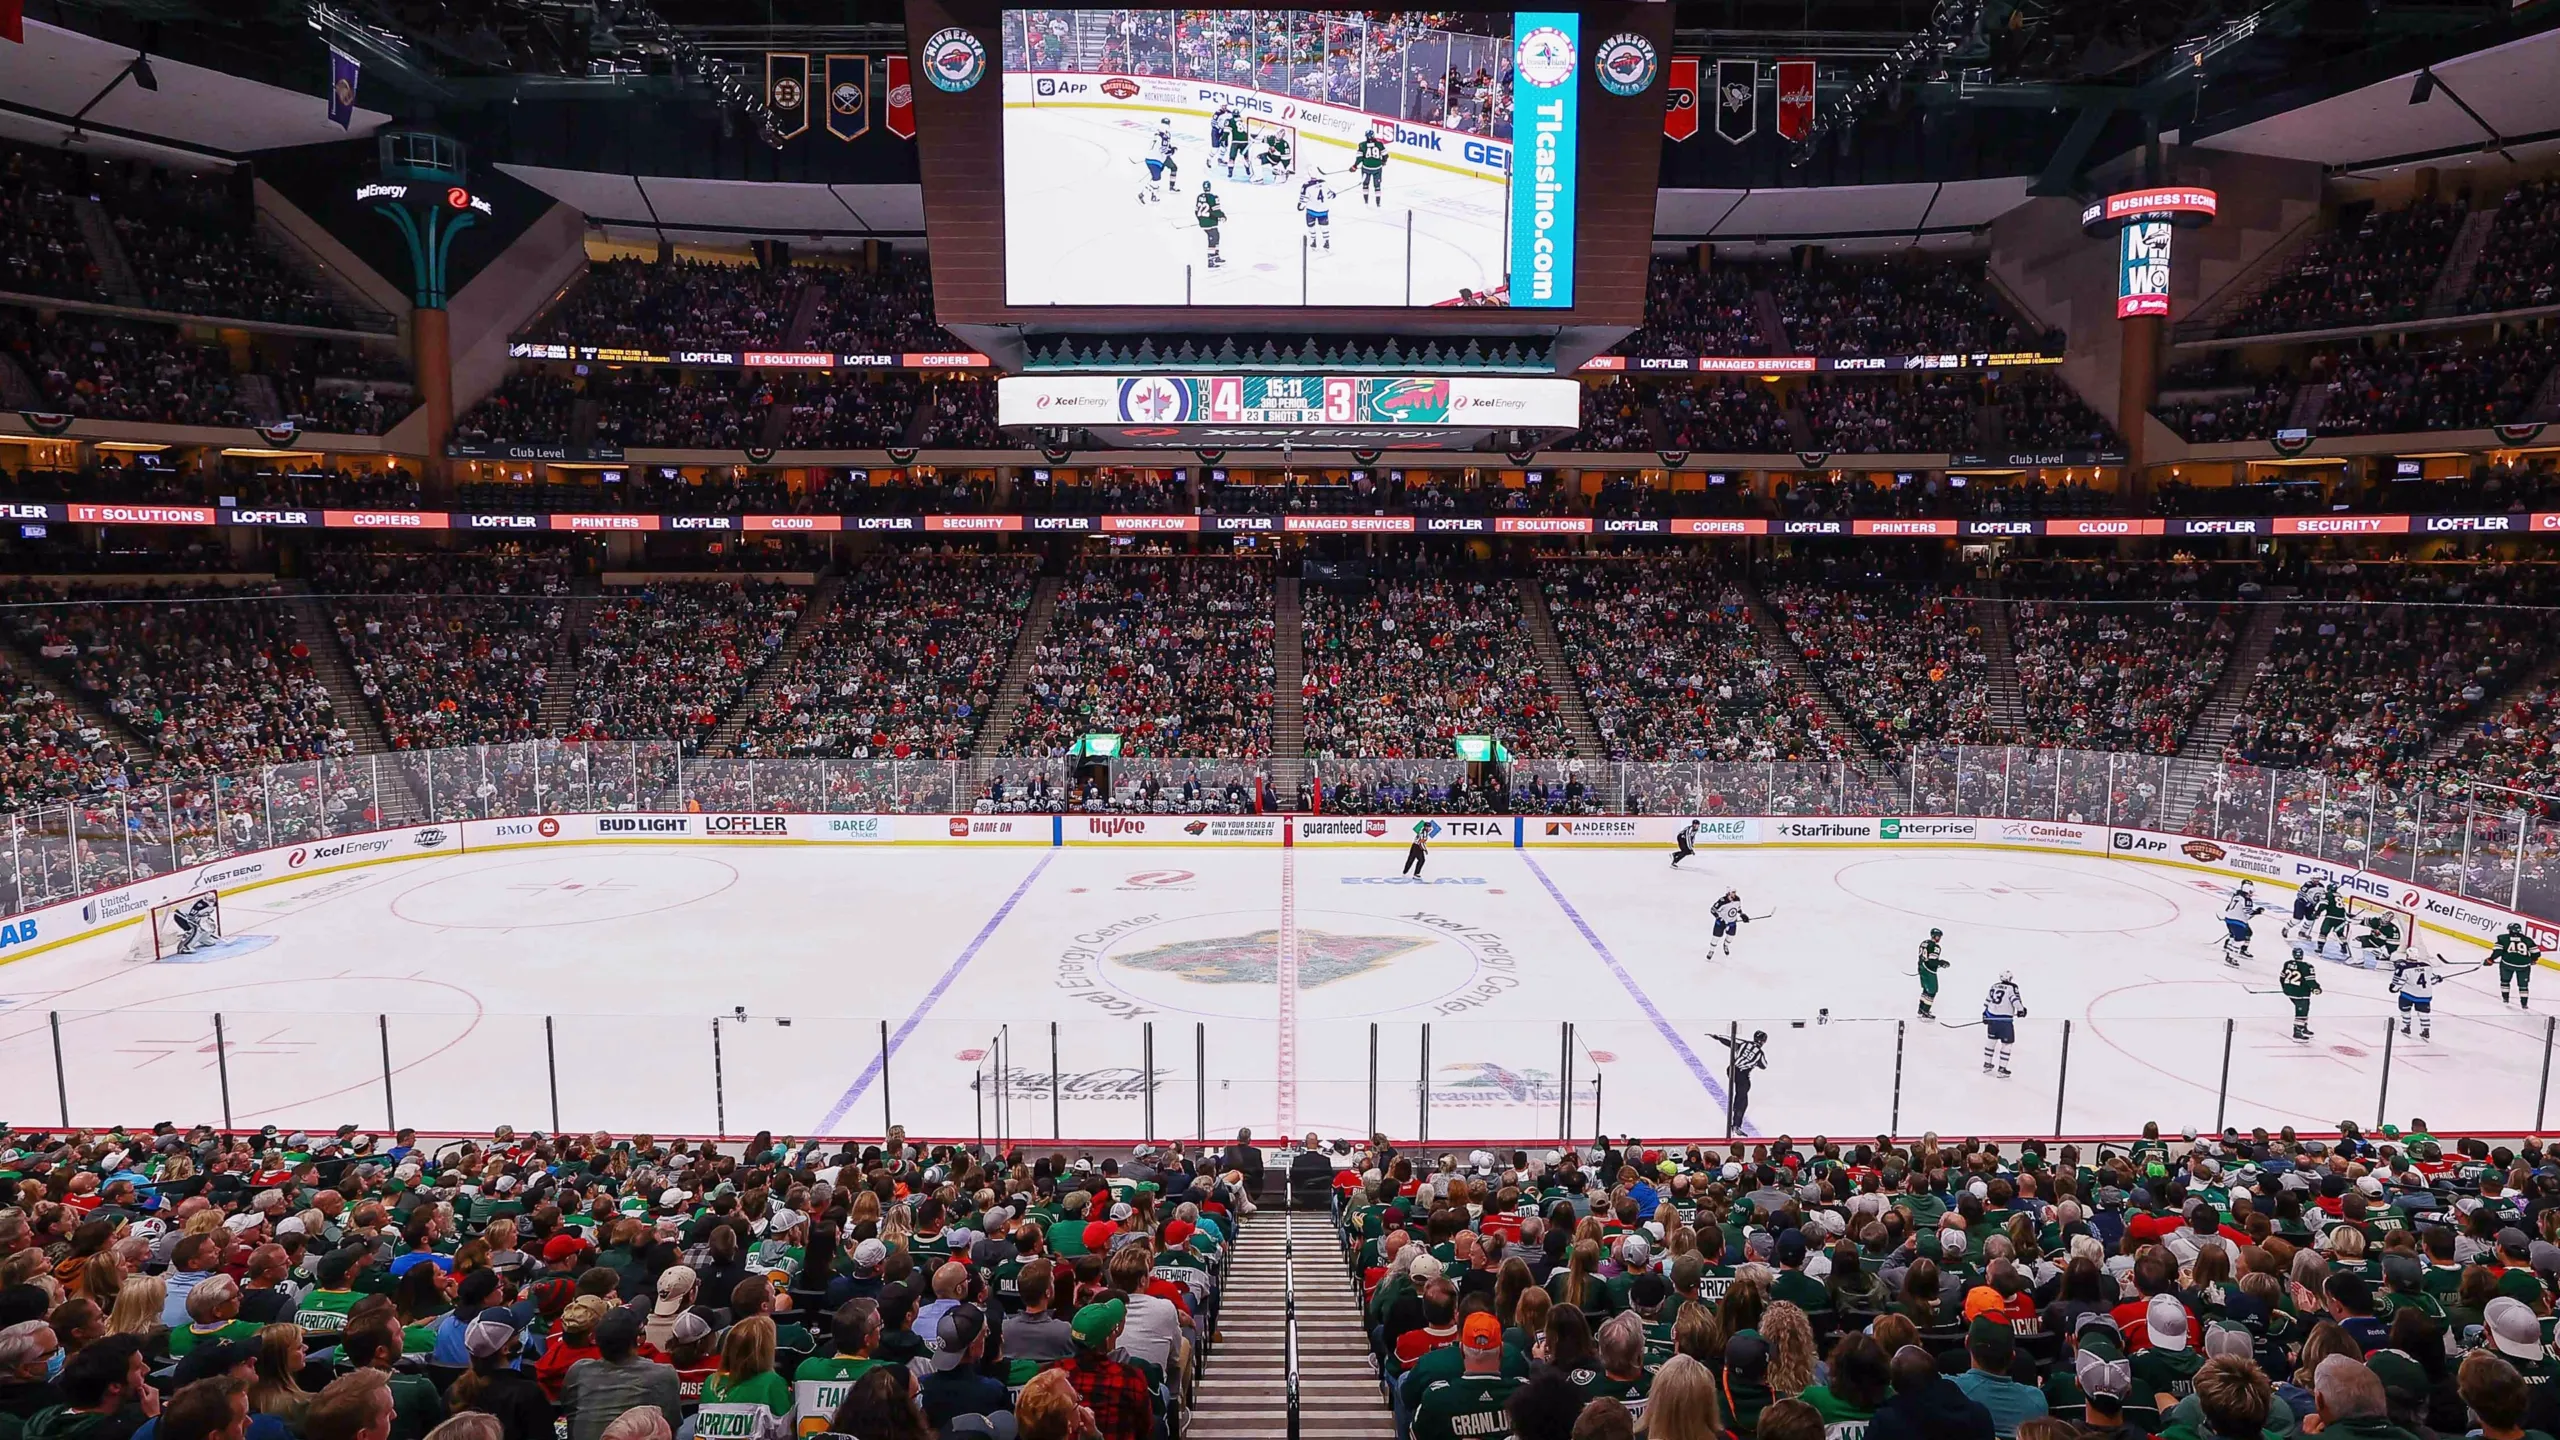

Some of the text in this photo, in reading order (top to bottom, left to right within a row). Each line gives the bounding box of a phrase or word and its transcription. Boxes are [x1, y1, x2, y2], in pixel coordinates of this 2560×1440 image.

[926, 30, 984, 56] MINNESOTA
[1597, 33, 1655, 61] MINNESOTA
[941, 78, 971, 90] WILD
[1611, 81, 1649, 92] WILD
[1300, 109, 1352, 132] Xcel Energy
[1396, 127, 1442, 152] bank
[369, 184, 407, 198] Energy
[1317, 189, 1324, 203] 4
[2111, 194, 2180, 212] BUSINESS
[681, 352, 733, 364] LOFFLER
[750, 355, 827, 365] IT SOLUTIONS
[844, 355, 892, 366] LOFFLER
[922, 355, 969, 365] COPIERS
[1640, 358, 1688, 369] LOFFLER
[1703, 359, 1811, 369] MANAGED SERVICES
[1834, 358, 1885, 370] LOFFLER
[1265, 380, 1302, 397] 15:11
[1055, 397, 1109, 407] Xcel Energy
[1214, 381, 1239, 420] 4
[1260, 398, 1308, 409] 3RD PERIOD
[1328, 382, 1352, 421] 3
[1472, 398, 1527, 409] Xcel Energy
[1247, 411, 1320, 421] 23 SHOTS 25
[510, 448, 565, 459] Club Level
[2009, 454, 2063, 465] Club Level
[79, 507, 205, 522] IT SOLUTIONS
[232, 511, 308, 524] LOFFLER
[353, 514, 421, 526] COPIERS
[471, 515, 536, 527] LOFFLER
[571, 517, 639, 528] PRINTERS
[672, 517, 730, 529] LOFFLER
[771, 518, 814, 530] CLOUD
[858, 518, 913, 529] LOFFLER
[942, 518, 1004, 529] SECURITY
[1034, 518, 1089, 529] LOFFLER
[1115, 518, 1185, 529] WORKFLOW
[1217, 518, 1272, 529] LOFFLER
[1285, 519, 1411, 531] MANAGED SERVICES
[1428, 519, 1483, 530] LOFFLER
[1501, 520, 1586, 532] IT SOLUTIONS
[1604, 520, 1658, 531] LOFFLER
[1692, 521, 1745, 532] COPIERS
[2185, 521, 2256, 533] LOFFLER
[2297, 519, 2381, 532] SECURITY
[2427, 517, 2509, 531] LOFFLER
[1784, 522, 1840, 533] LOFFLER
[1872, 523, 1937, 533] PRINTERS
[1970, 522, 2032, 534] LOFFLER
[2078, 522, 2129, 533] CLOUD
[600, 819, 687, 832] BUD LIGHT
[705, 816, 787, 831] LOFFLER
[833, 820, 865, 831] BARE
[973, 822, 1001, 833] GAME
[1002, 822, 1013, 833] ON
[1211, 821, 1275, 829] FIND YOUR SEATS AT
[1303, 820, 1386, 838] guaranteed Rate
[1447, 822, 1503, 836] TRIA
[1574, 822, 1635, 831] ANDERSEN
[1700, 822, 1733, 833] BARE
[1888, 823, 1974, 835] enterprise
[496, 824, 532, 836] BMO
[851, 830, 878, 839] Chicken
[1212, 828, 1274, 837] WILD.COM/TICKETS
[1792, 824, 1871, 837] StarTribune
[2030, 825, 2083, 839] Canidae
[313, 839, 390, 860] Xcel Energy
[2230, 857, 2281, 876] HOCKEYLODGE.COM
[203, 869, 232, 886] WEST
[232, 864, 262, 879] BEND
[1340, 876, 1487, 885] ECOLAB
[100, 892, 130, 909] United
[101, 897, 149, 919] Healthcare
[2425, 898, 2498, 932] Xcel Energy
[2506, 941, 2528, 956] 49
[1056, 911, 1162, 1020] Xcel Energy Center
[1399, 911, 1520, 1017] Xcel Energy Center
[2284, 969, 2302, 986] 22
[2417, 973, 2427, 989] 4
[1741, 1048, 1756, 1061] 59
[2374, 1218, 2402, 1230] SUTER
[1156, 1269, 1192, 1282] STEWART
[2367, 1328, 2385, 1337] Reebok
